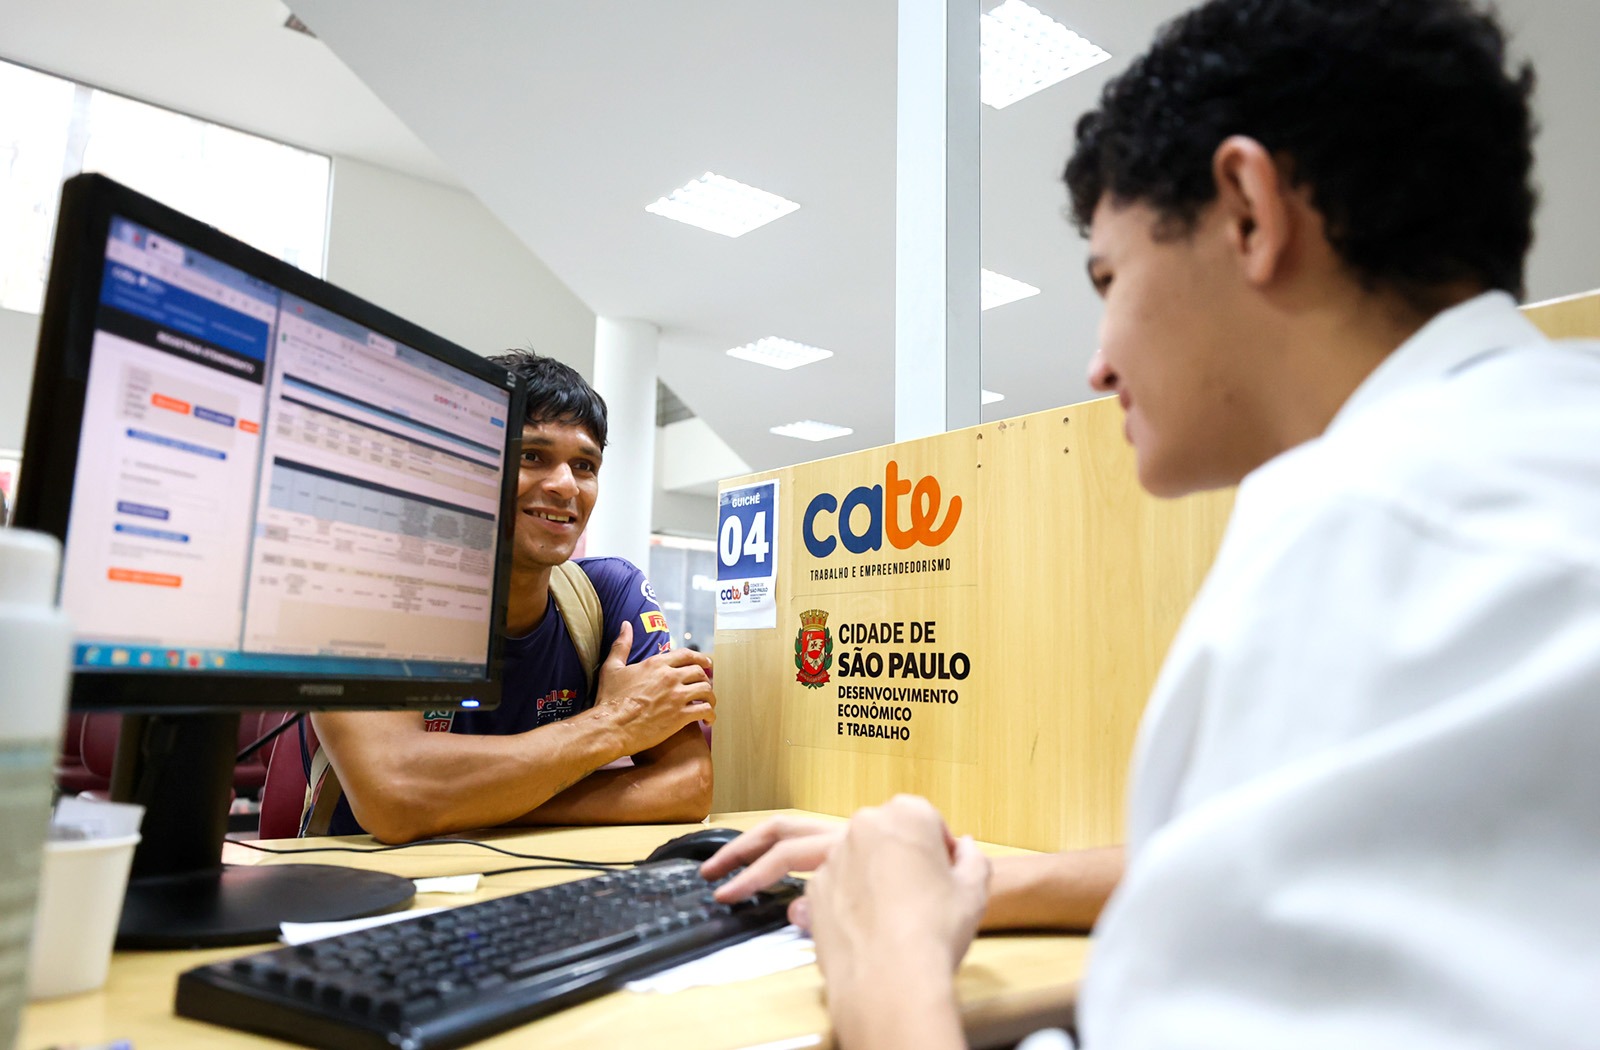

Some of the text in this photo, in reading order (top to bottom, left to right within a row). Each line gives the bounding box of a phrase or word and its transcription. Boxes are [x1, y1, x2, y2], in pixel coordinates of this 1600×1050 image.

[732, 493, 761, 508] GUICHÊ
[803, 460, 963, 558] cate
[720, 511, 769, 567] 04
[810, 558, 951, 581] TRABALHO E EMPREENDEDORISMO
[720, 586, 742, 601] cate
[838, 621, 936, 644] CIDADE DE
[838, 647, 971, 681] SÃO PAULO
[838, 685, 959, 705] DESENVOLVIMENTO
[838, 701, 912, 721] ECONÔMICO
[838, 722, 910, 741] E TRABALHO
